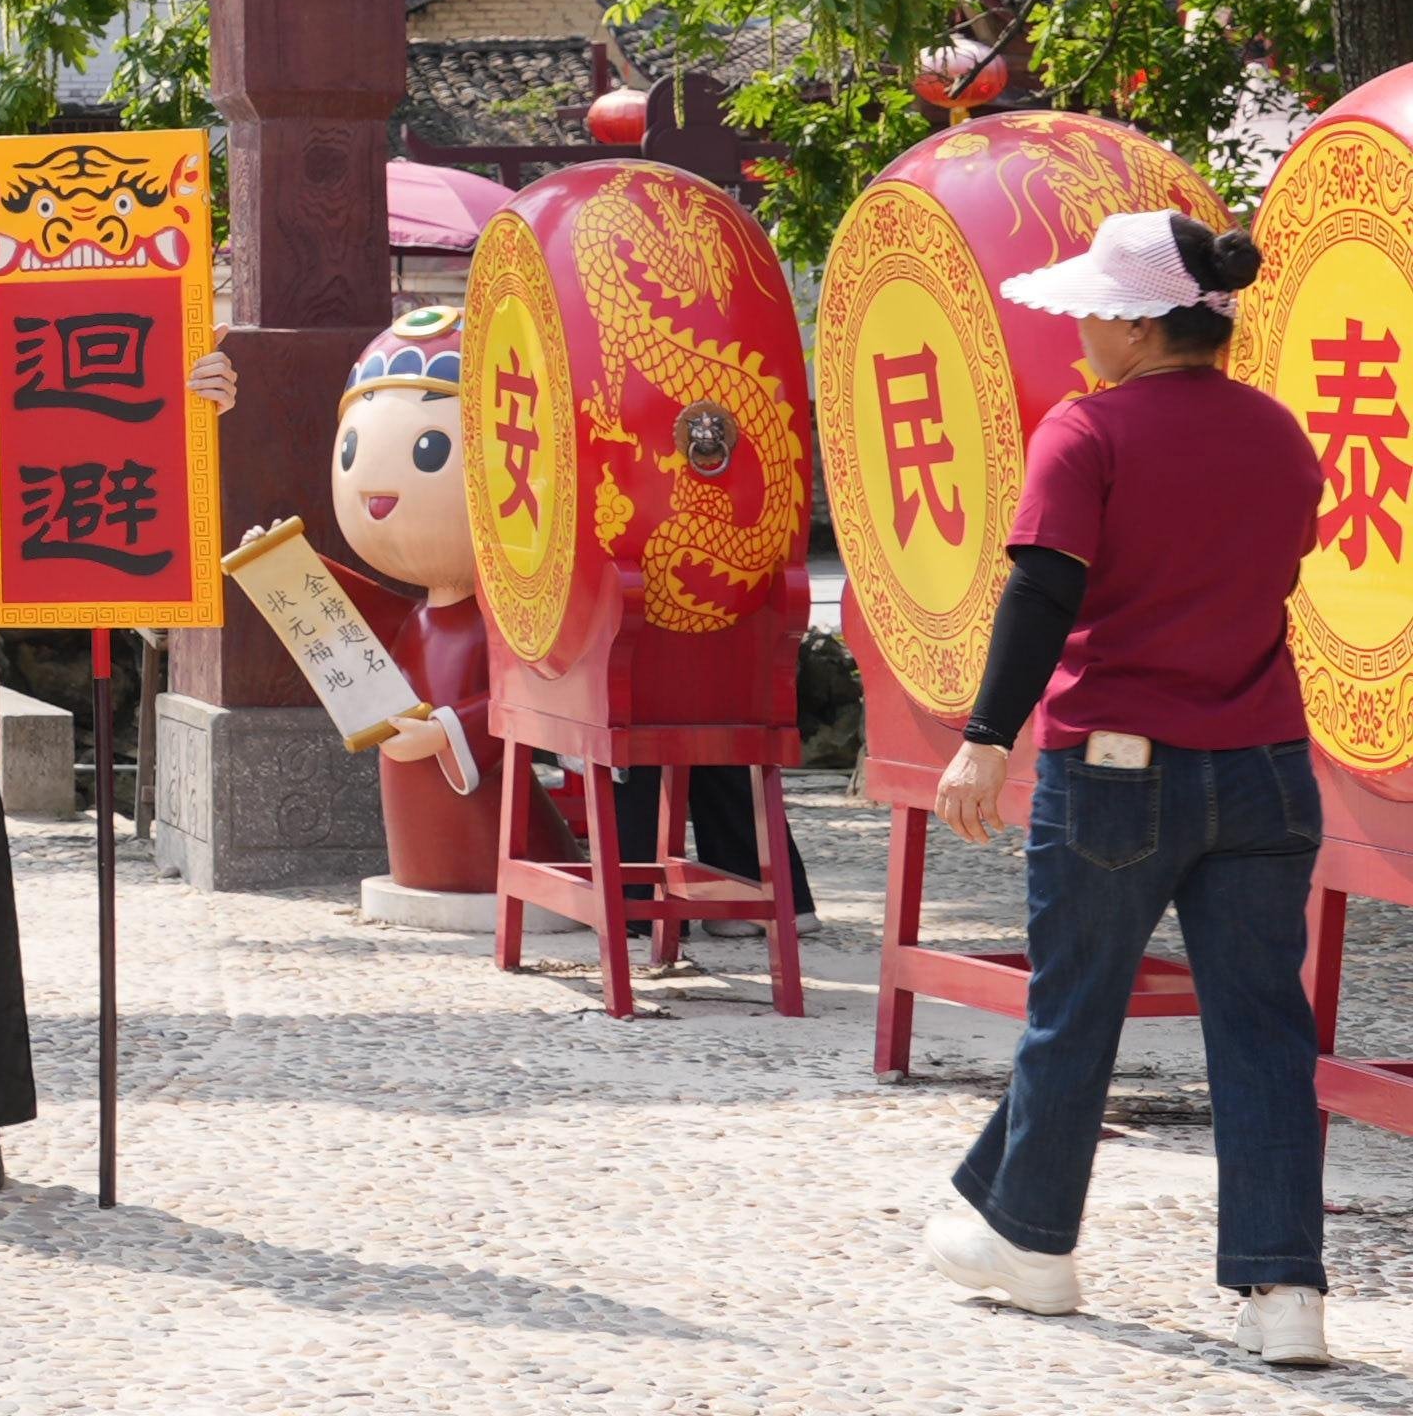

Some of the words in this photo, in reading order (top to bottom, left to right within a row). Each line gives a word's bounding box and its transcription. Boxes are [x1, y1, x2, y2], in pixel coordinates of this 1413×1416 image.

[494, 345, 540, 530] 安
[873, 342, 965, 549] 民
[1306, 317, 1413, 571] 泰
[266, 589, 355, 692] 状元福地
[303, 572, 386, 675] 金榜题名
